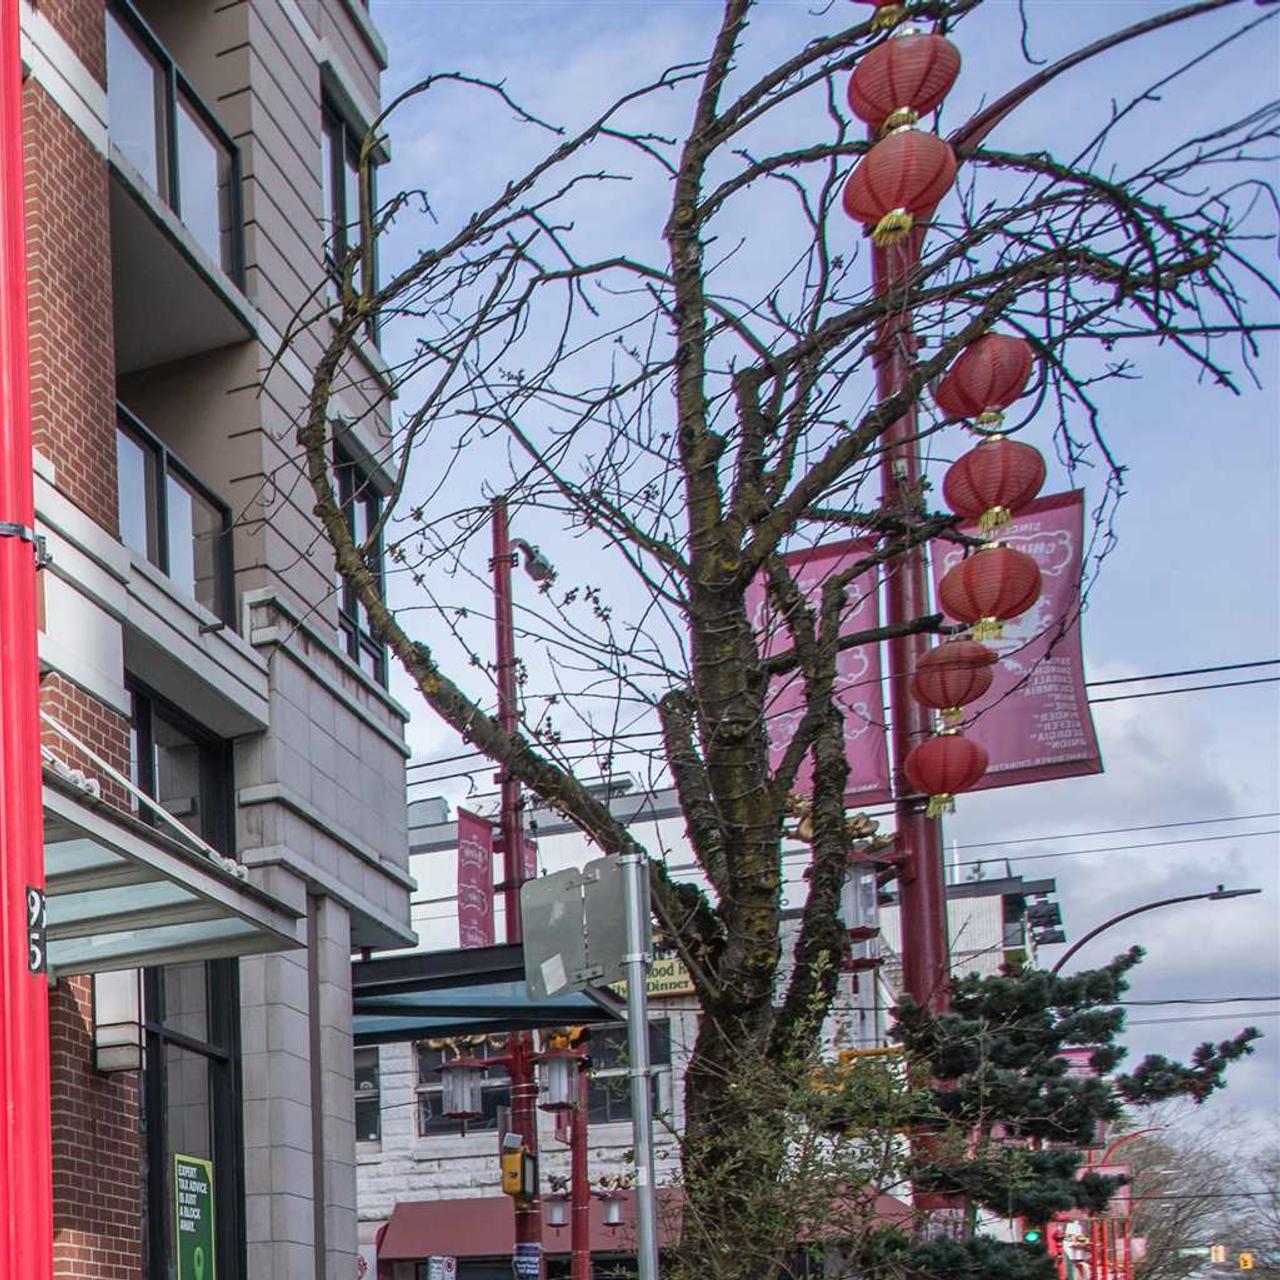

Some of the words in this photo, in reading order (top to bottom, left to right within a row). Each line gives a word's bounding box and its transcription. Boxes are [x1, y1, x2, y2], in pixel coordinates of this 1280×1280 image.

[646, 964, 674, 978] ood
[647, 980, 689, 992] Dinner
[178, 1164, 198, 1178] EXPERT
[189, 1181, 208, 1194] ADVICE
[184, 1206, 201, 1219] BLOCK
